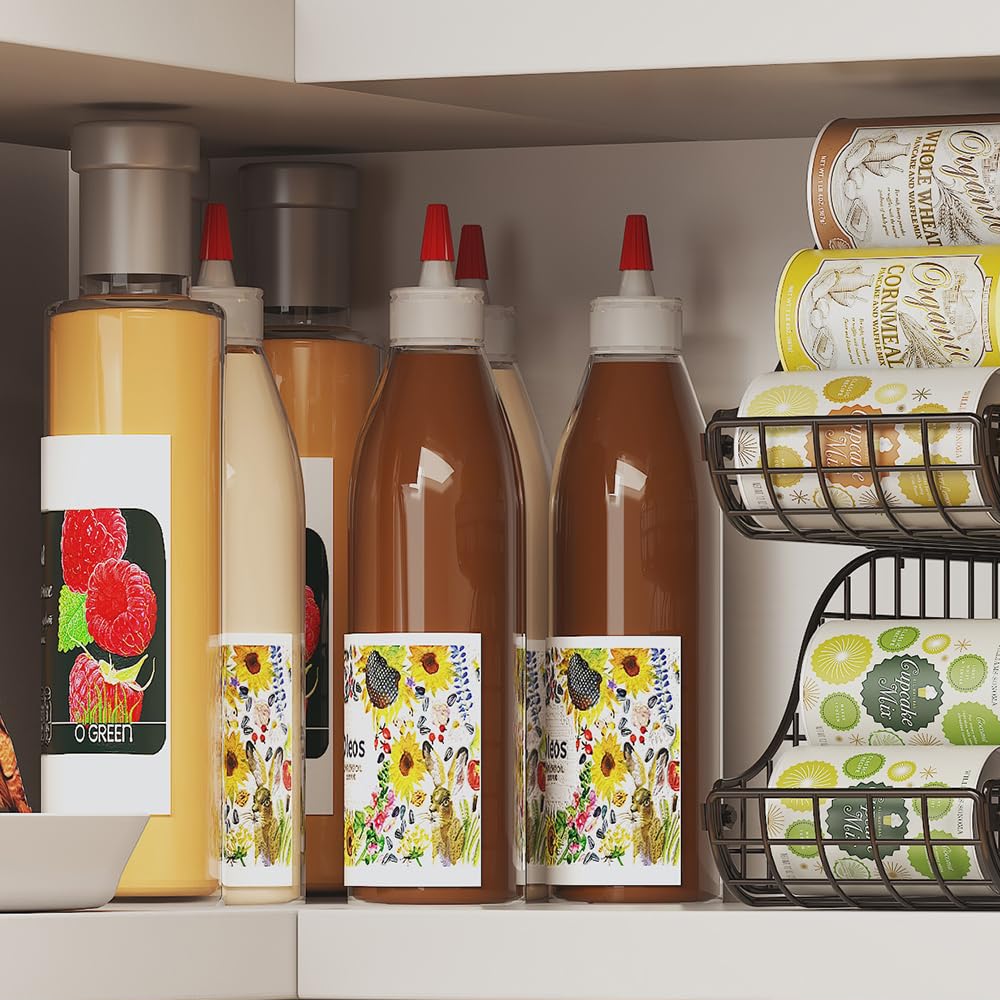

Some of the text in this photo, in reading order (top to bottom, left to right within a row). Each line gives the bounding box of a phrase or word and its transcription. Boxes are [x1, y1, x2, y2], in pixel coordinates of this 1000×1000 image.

[909, 137, 922, 169] PANCAKE
[918, 130, 943, 246] WHOLE WHEAT
[881, 264, 905, 368] CORNMEAL
[902, 262, 971, 363] Organic
[825, 430, 847, 475] Mi
[878, 678, 898, 720] Mix
[896, 660, 919, 726] Cupcake
[844, 805, 863, 841] Mi
